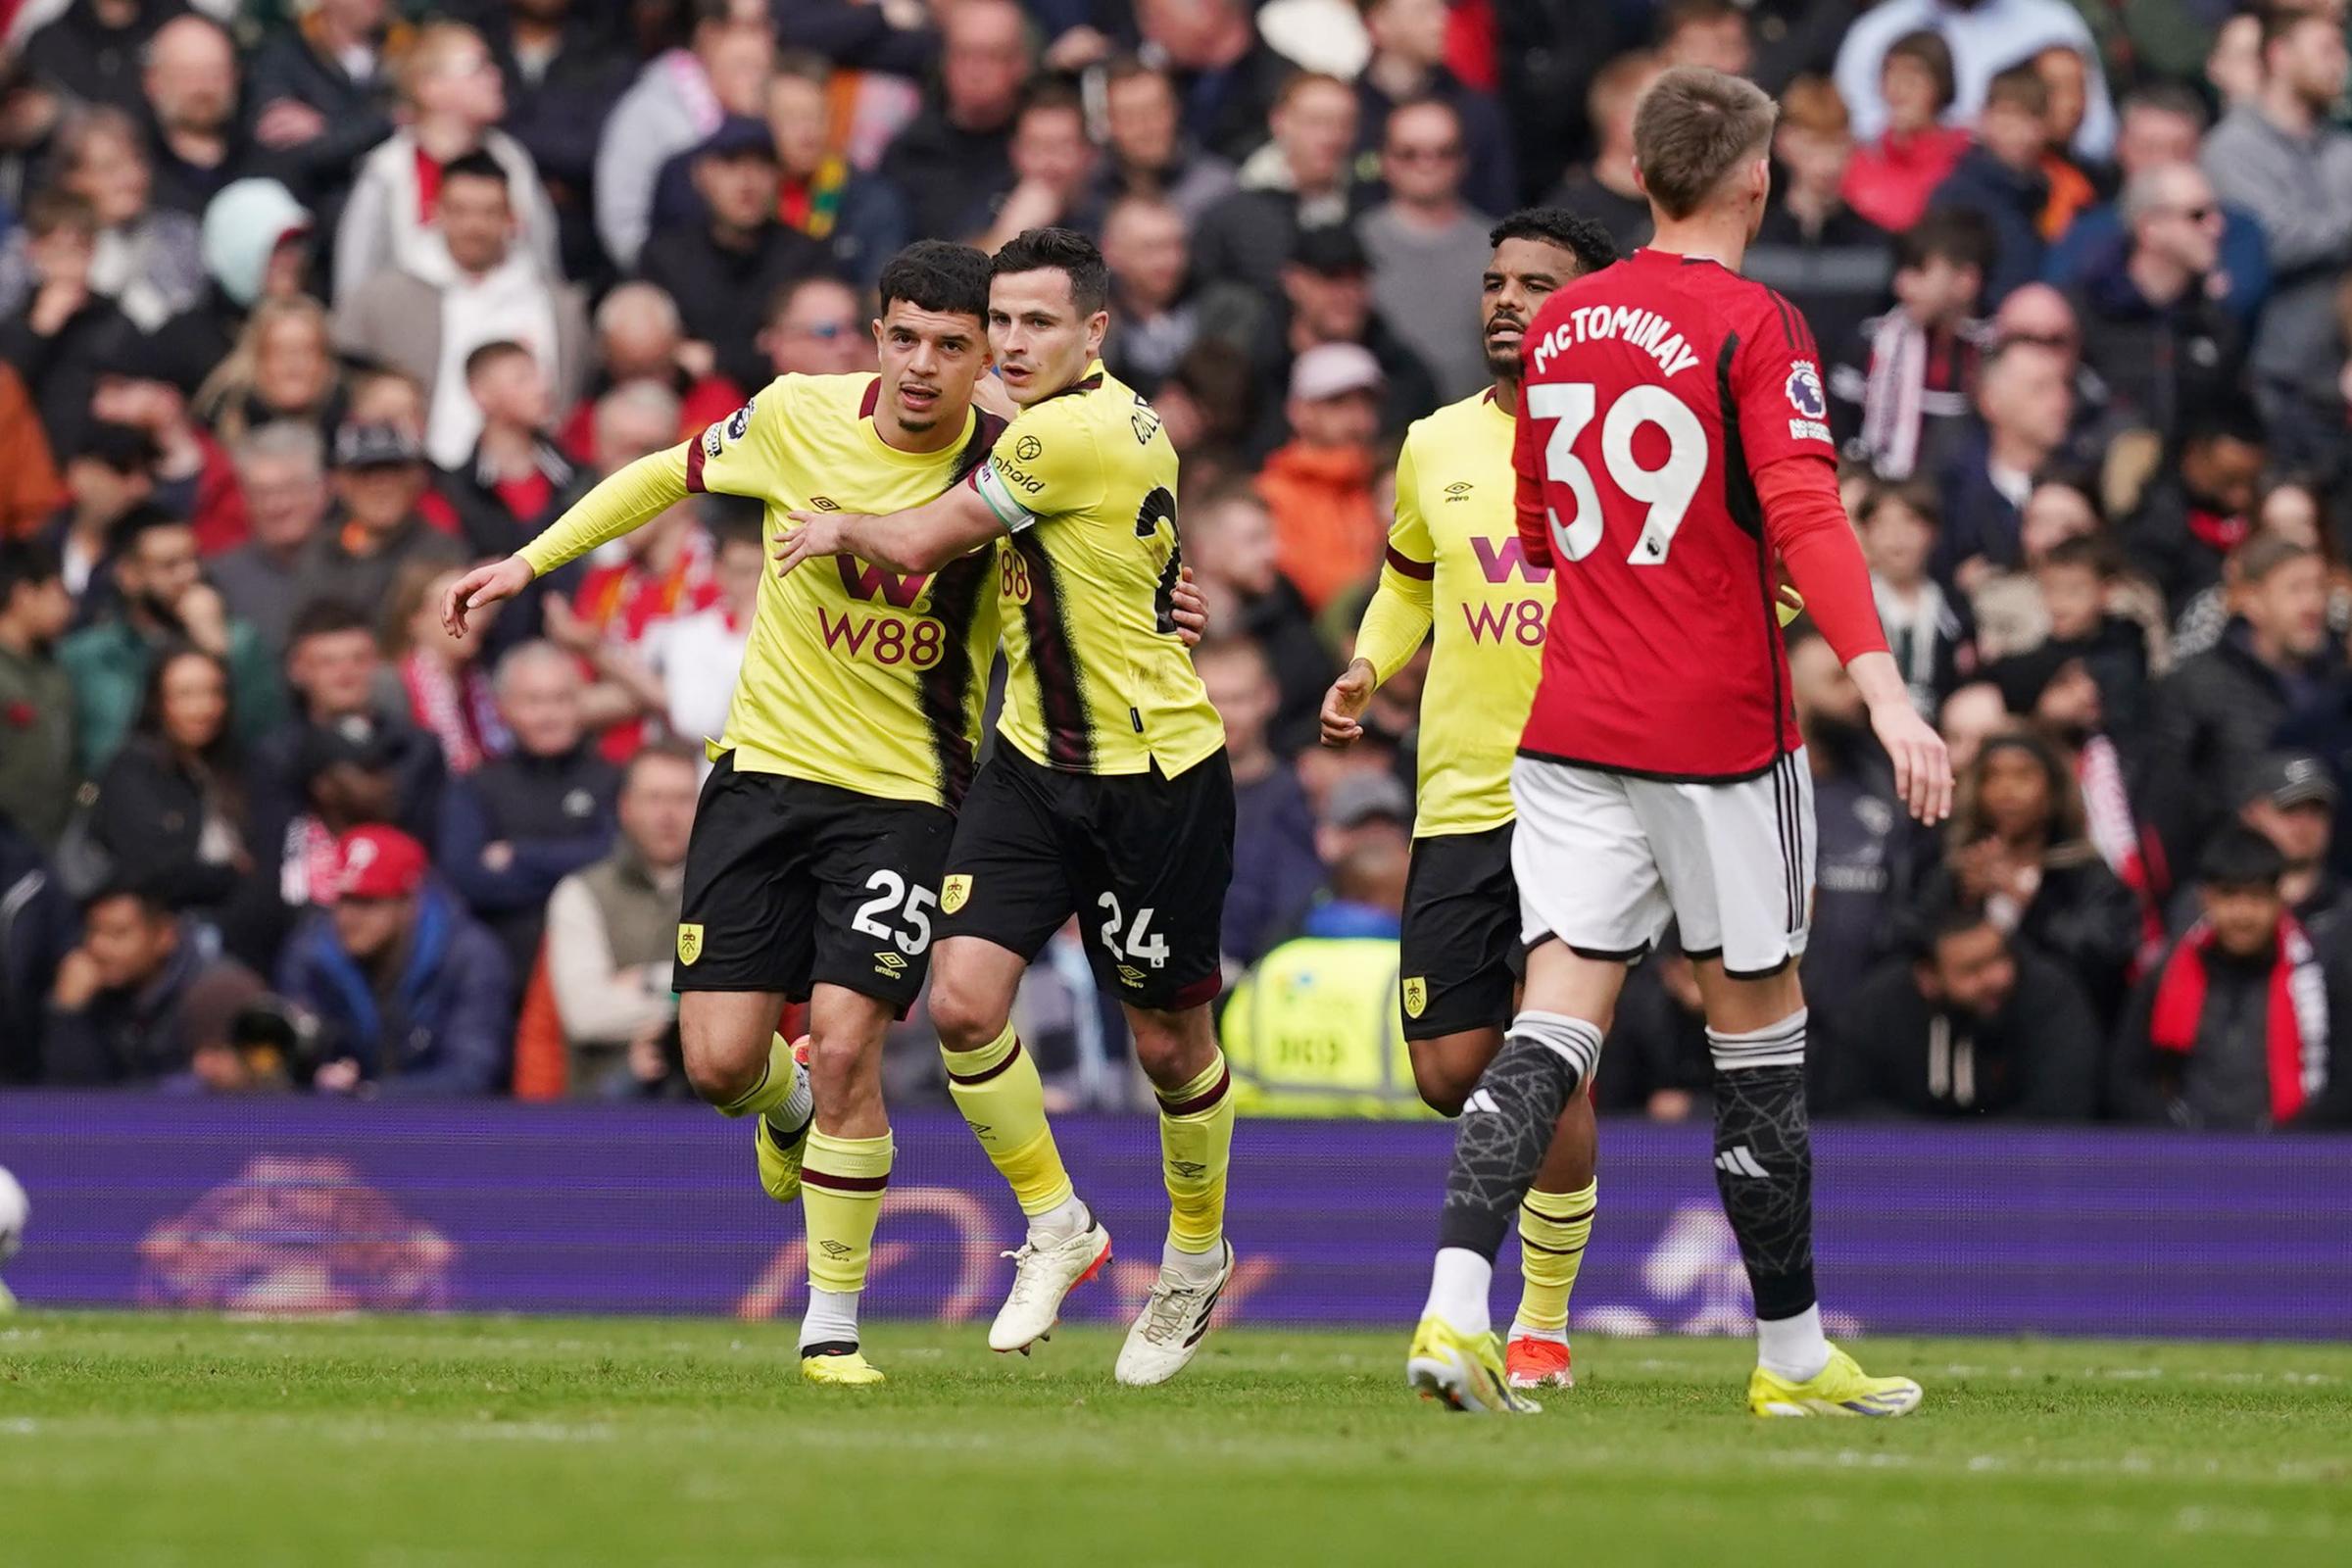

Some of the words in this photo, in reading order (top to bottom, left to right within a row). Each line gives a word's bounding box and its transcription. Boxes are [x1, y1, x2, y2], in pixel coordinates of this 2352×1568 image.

[1527, 382, 1708, 565] 39
[1001, 549, 1029, 601] 88
[1136, 486, 1182, 633] 2
[817, 606, 940, 666] W88
[1462, 599, 1545, 646] W8
[852, 869, 937, 956] 25
[1098, 891, 1170, 968] 24
[874, 965, 902, 980] umbro
